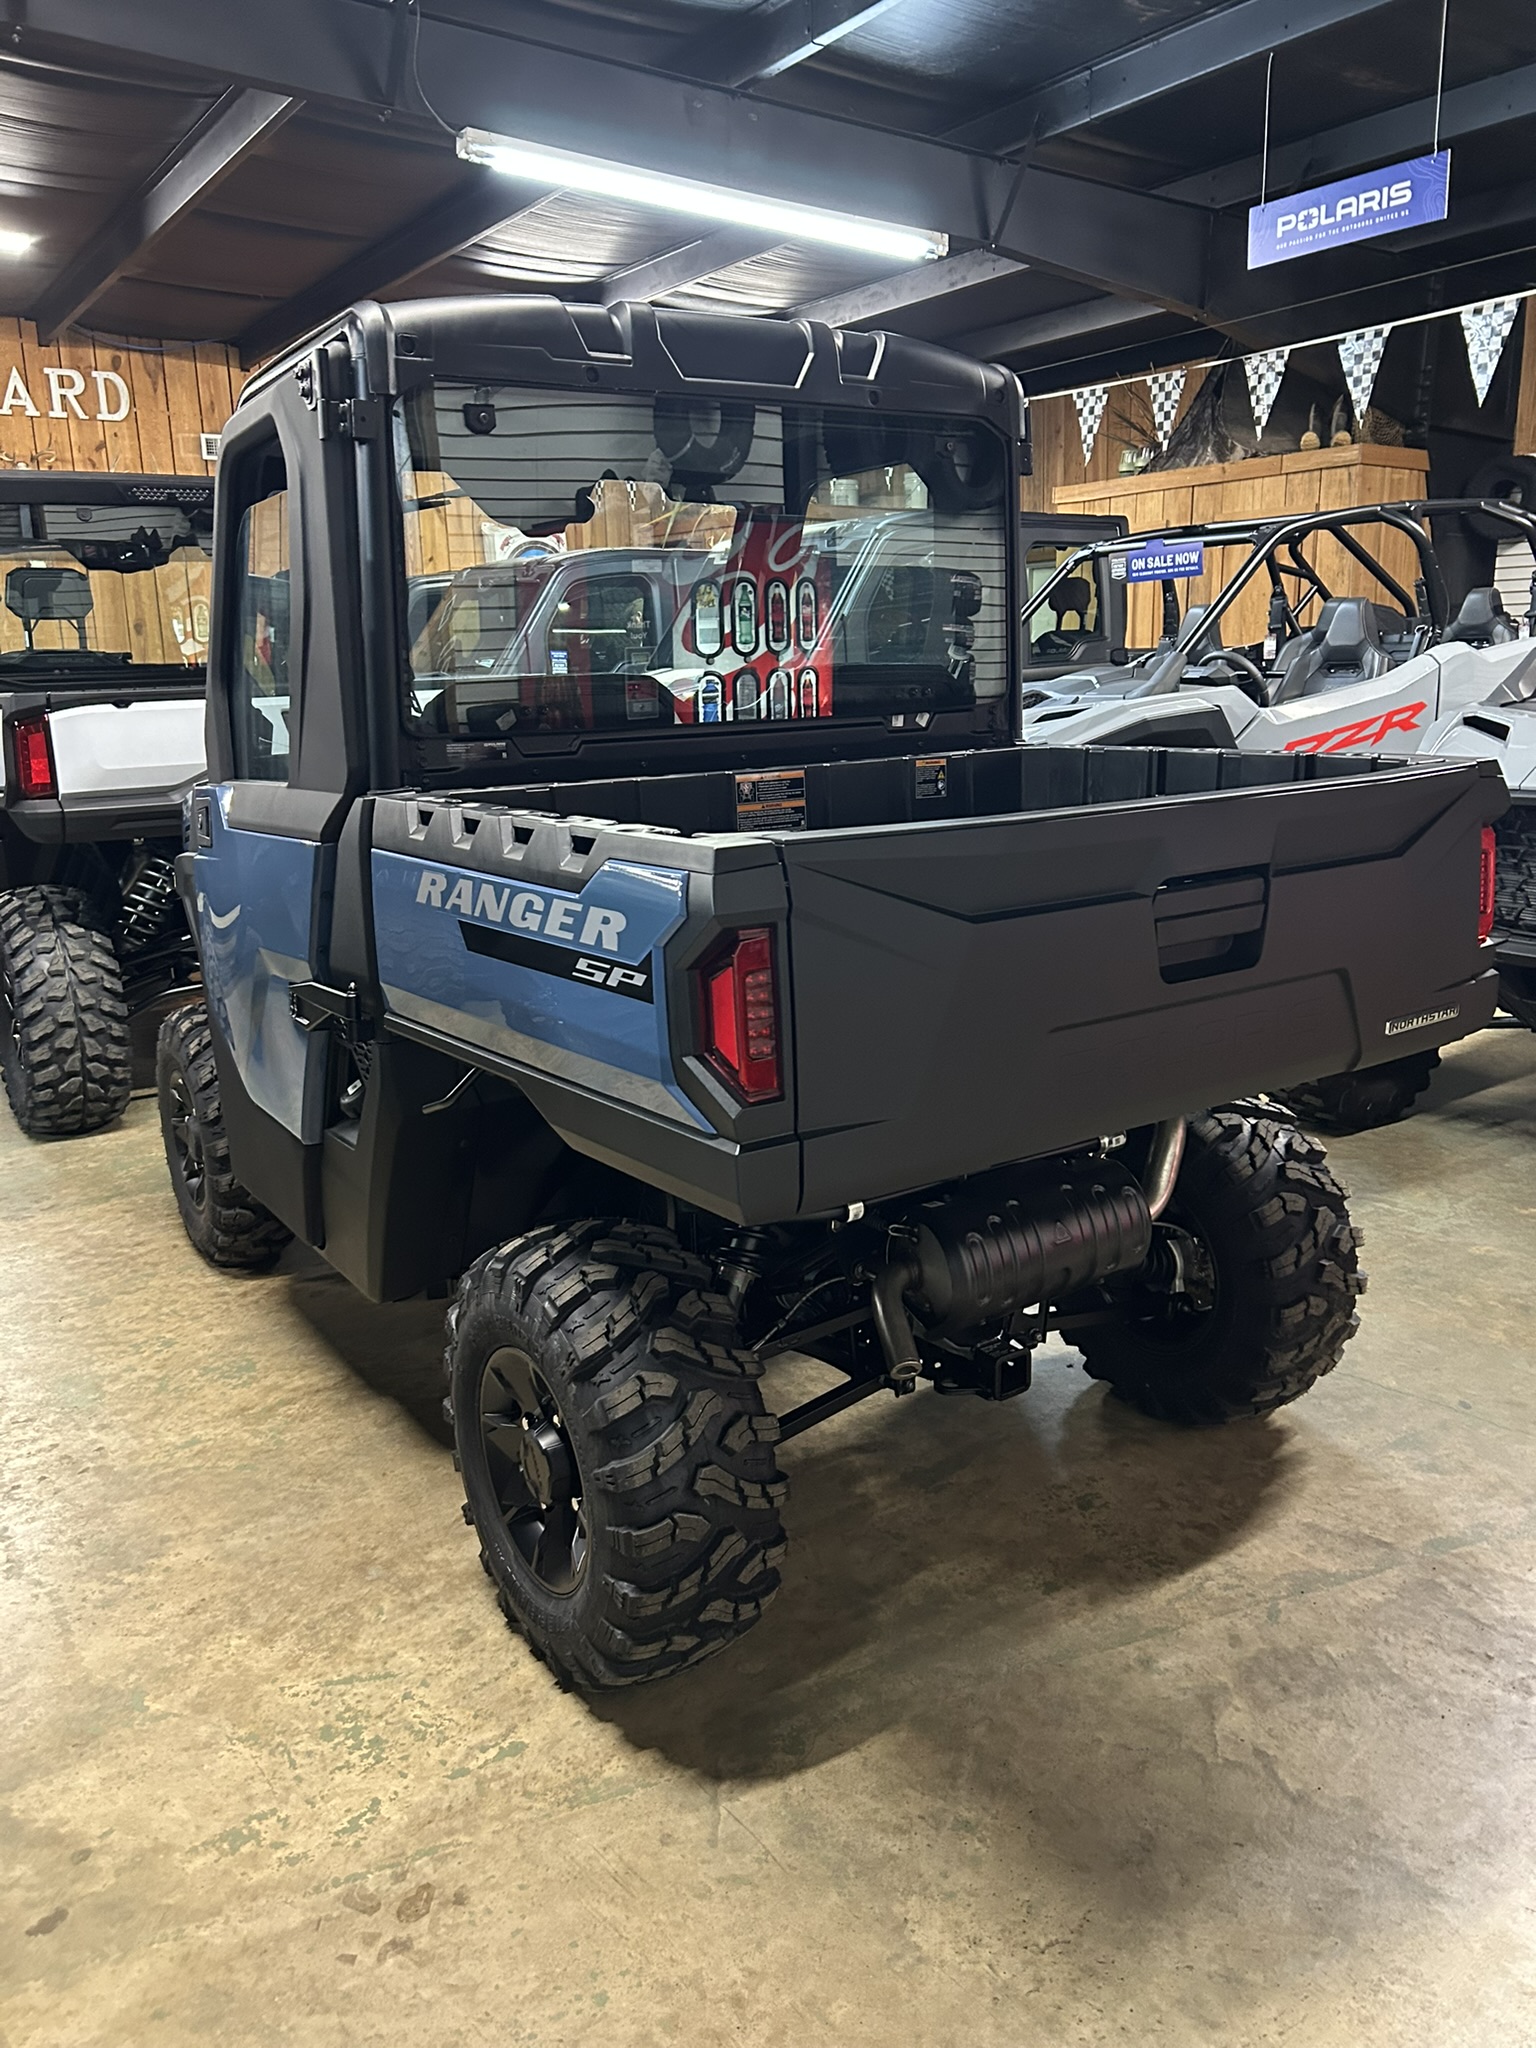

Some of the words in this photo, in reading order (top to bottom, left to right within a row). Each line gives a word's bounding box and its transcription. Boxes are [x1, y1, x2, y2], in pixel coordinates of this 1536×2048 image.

[1276, 180, 1413, 239] POLARIS
[0, 365, 131, 422] ARD
[1131, 557, 1146, 571] ON
[1146, 554, 1174, 569] SALE
[1175, 551, 1199, 565] NOW
[415, 869, 627, 951] RANGER
[572, 957, 648, 987] SP
[1389, 1006, 1459, 1033] NORTHSTAR
